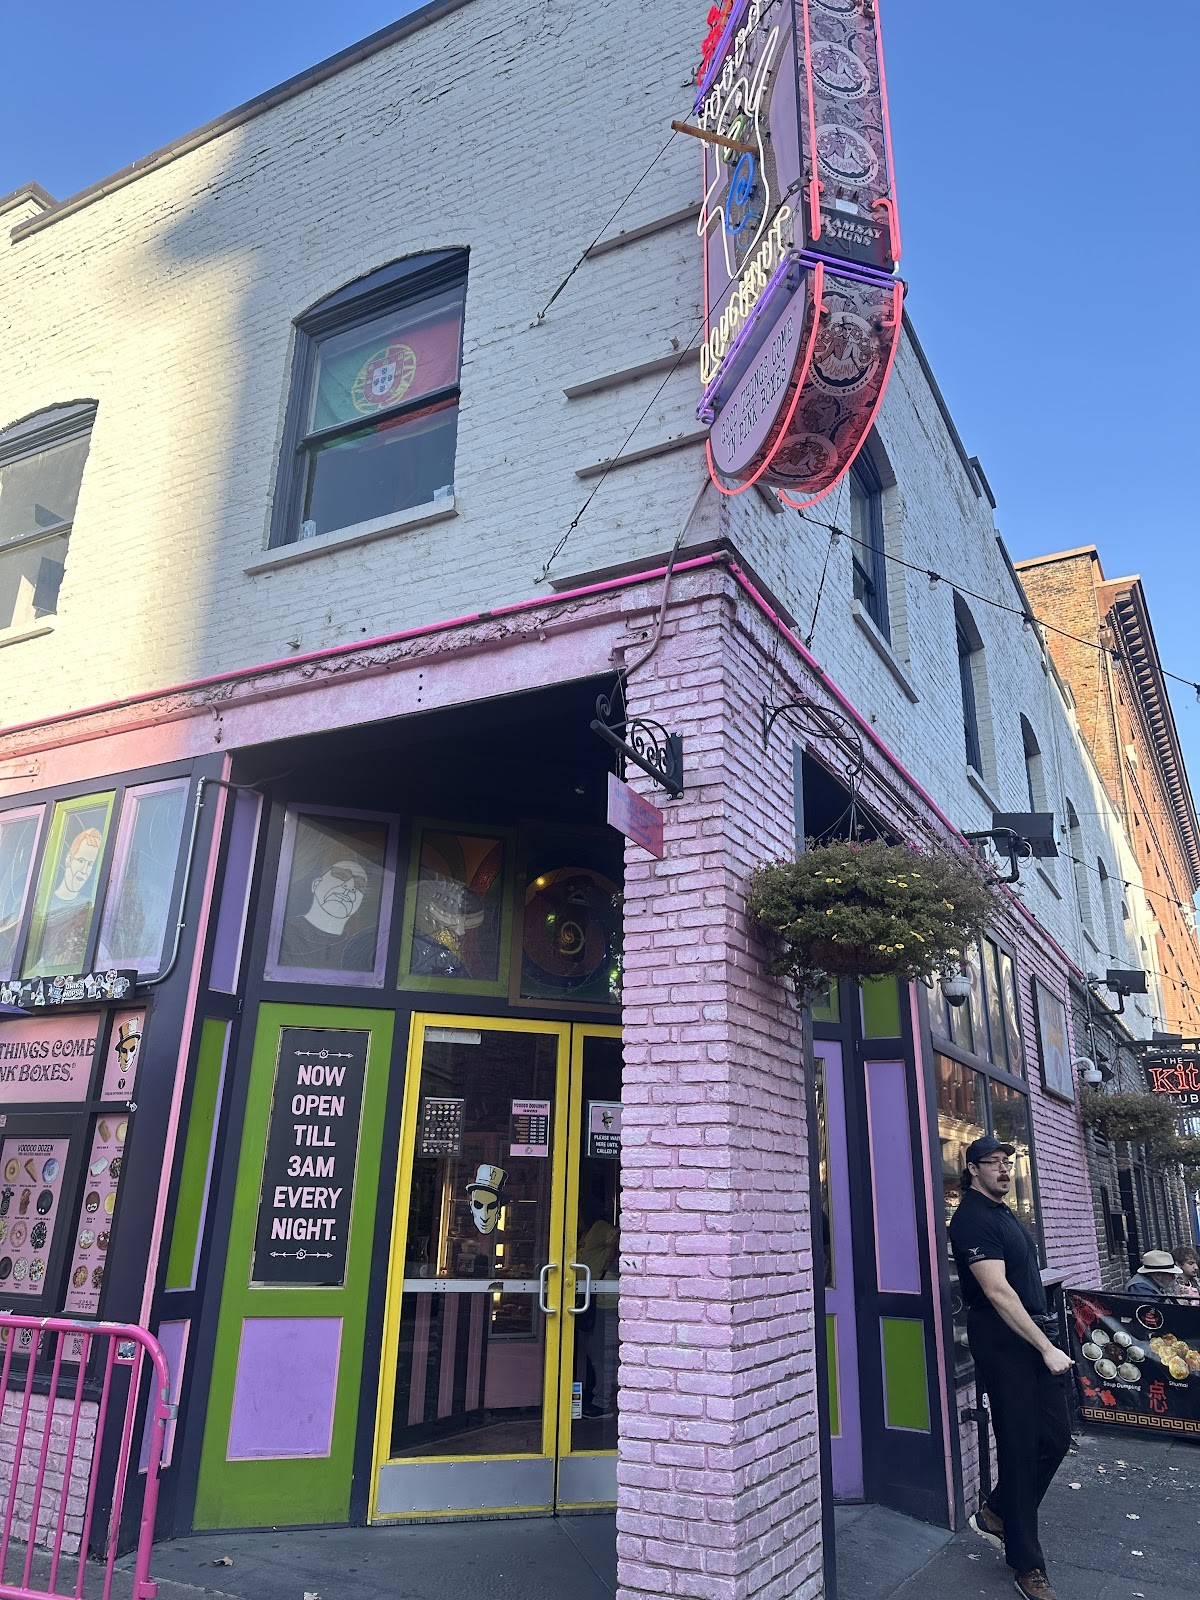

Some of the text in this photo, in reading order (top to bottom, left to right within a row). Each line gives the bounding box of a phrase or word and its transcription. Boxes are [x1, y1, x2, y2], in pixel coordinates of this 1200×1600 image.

[820, 212, 883, 239] RAMSAY
[825, 223, 872, 247] SIGNS
[721, 317, 794, 446] GOOD THINGS COME
[727, 356, 787, 463] IN PINK BOXES
[0, 1037, 96, 1060] THINGS COME
[0, 1064, 19, 1081] NK
[297, 1064, 346, 1087] NOW
[1148, 1062, 1200, 1094] Kit
[291, 1094, 345, 1117] OPEN
[293, 1124, 336, 1147] TILL
[37, 1143, 55, 1152] DOZEN
[287, 1155, 335, 1178] 3AM
[273, 1186, 343, 1209] EVERY
[271, 1217, 337, 1241] NIGHT.
[1148, 1379, 1169, 1414] 点心
